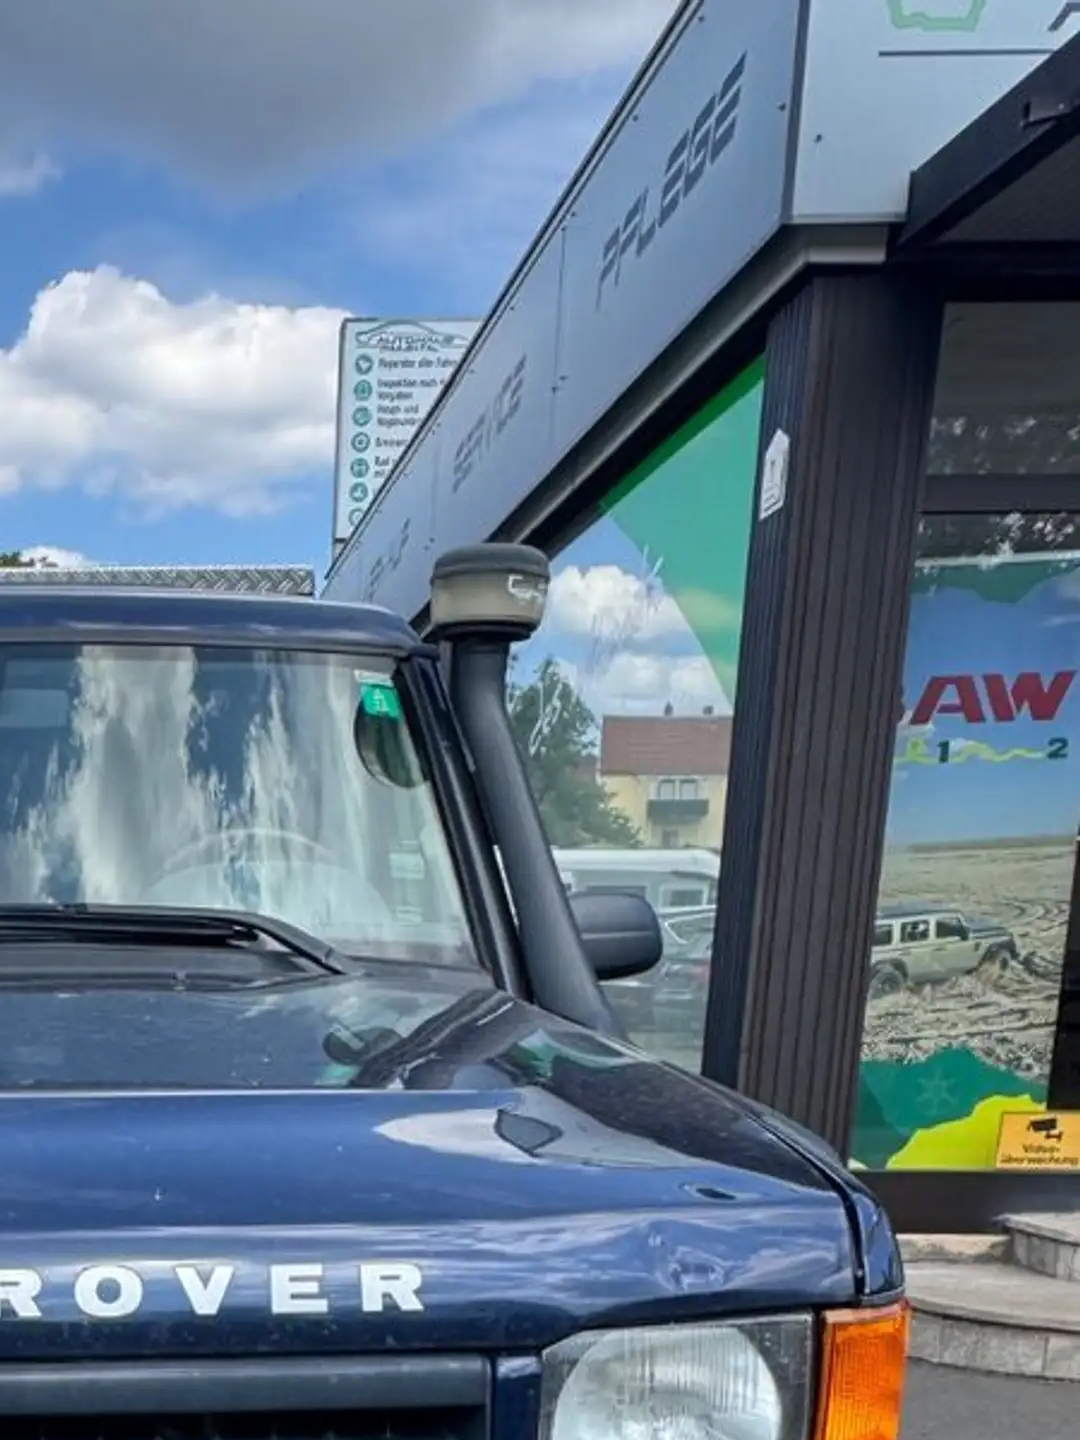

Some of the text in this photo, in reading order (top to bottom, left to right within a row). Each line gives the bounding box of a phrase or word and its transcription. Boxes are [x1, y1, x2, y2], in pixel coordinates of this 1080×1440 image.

[596, 50, 748, 312] PFLEGE
[898, 670, 1077, 726] AW
[1047, 737, 1069, 760] 2
